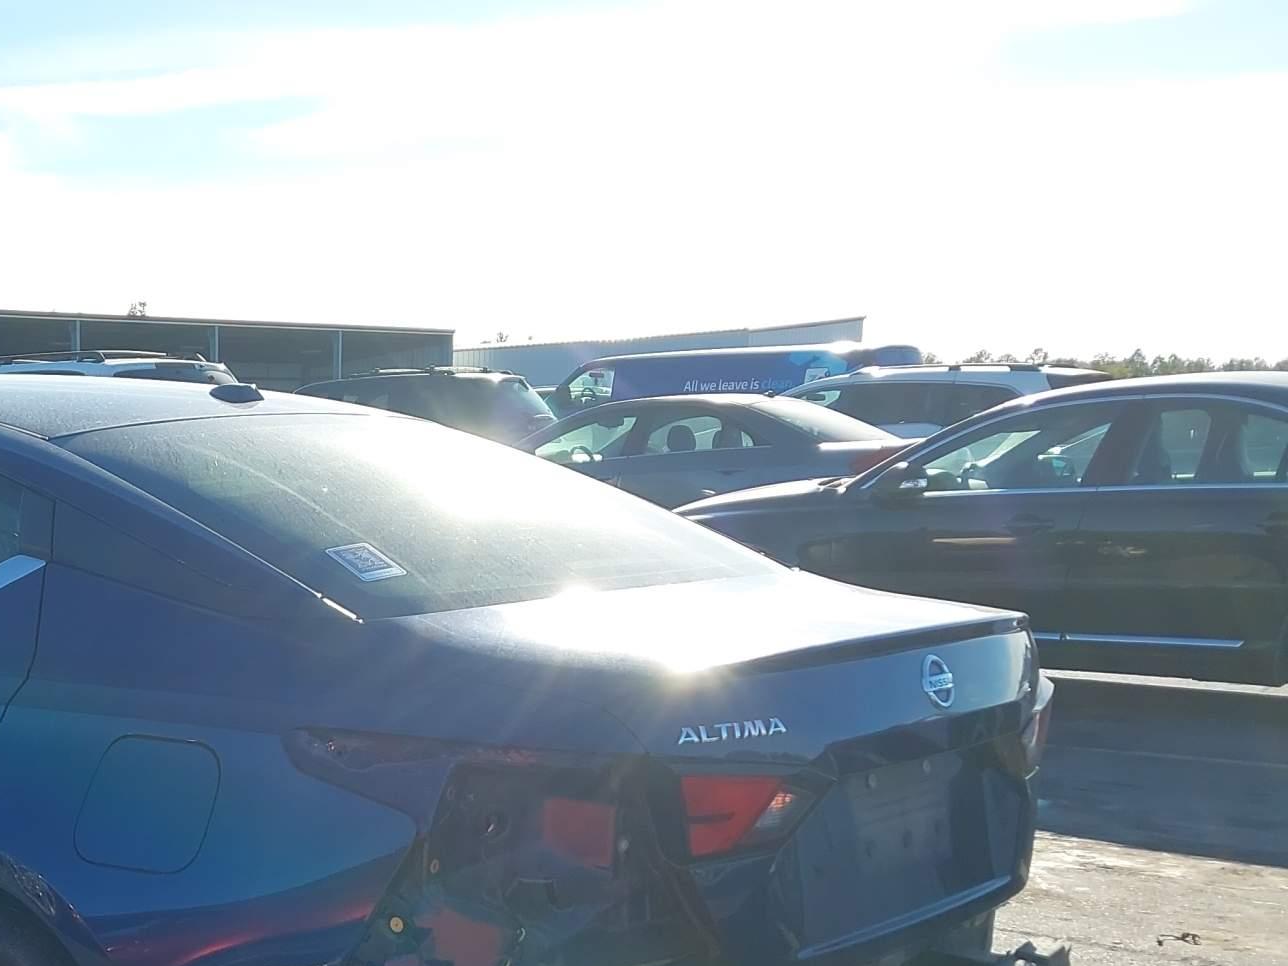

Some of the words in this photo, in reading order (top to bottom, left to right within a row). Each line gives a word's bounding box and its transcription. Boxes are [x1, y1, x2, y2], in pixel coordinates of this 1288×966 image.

[683, 380, 699, 392] All
[700, 383, 717, 392] we
[718, 379, 749, 391] leave
[750, 378, 760, 390] is
[678, 717, 787, 744] ALTIMA
